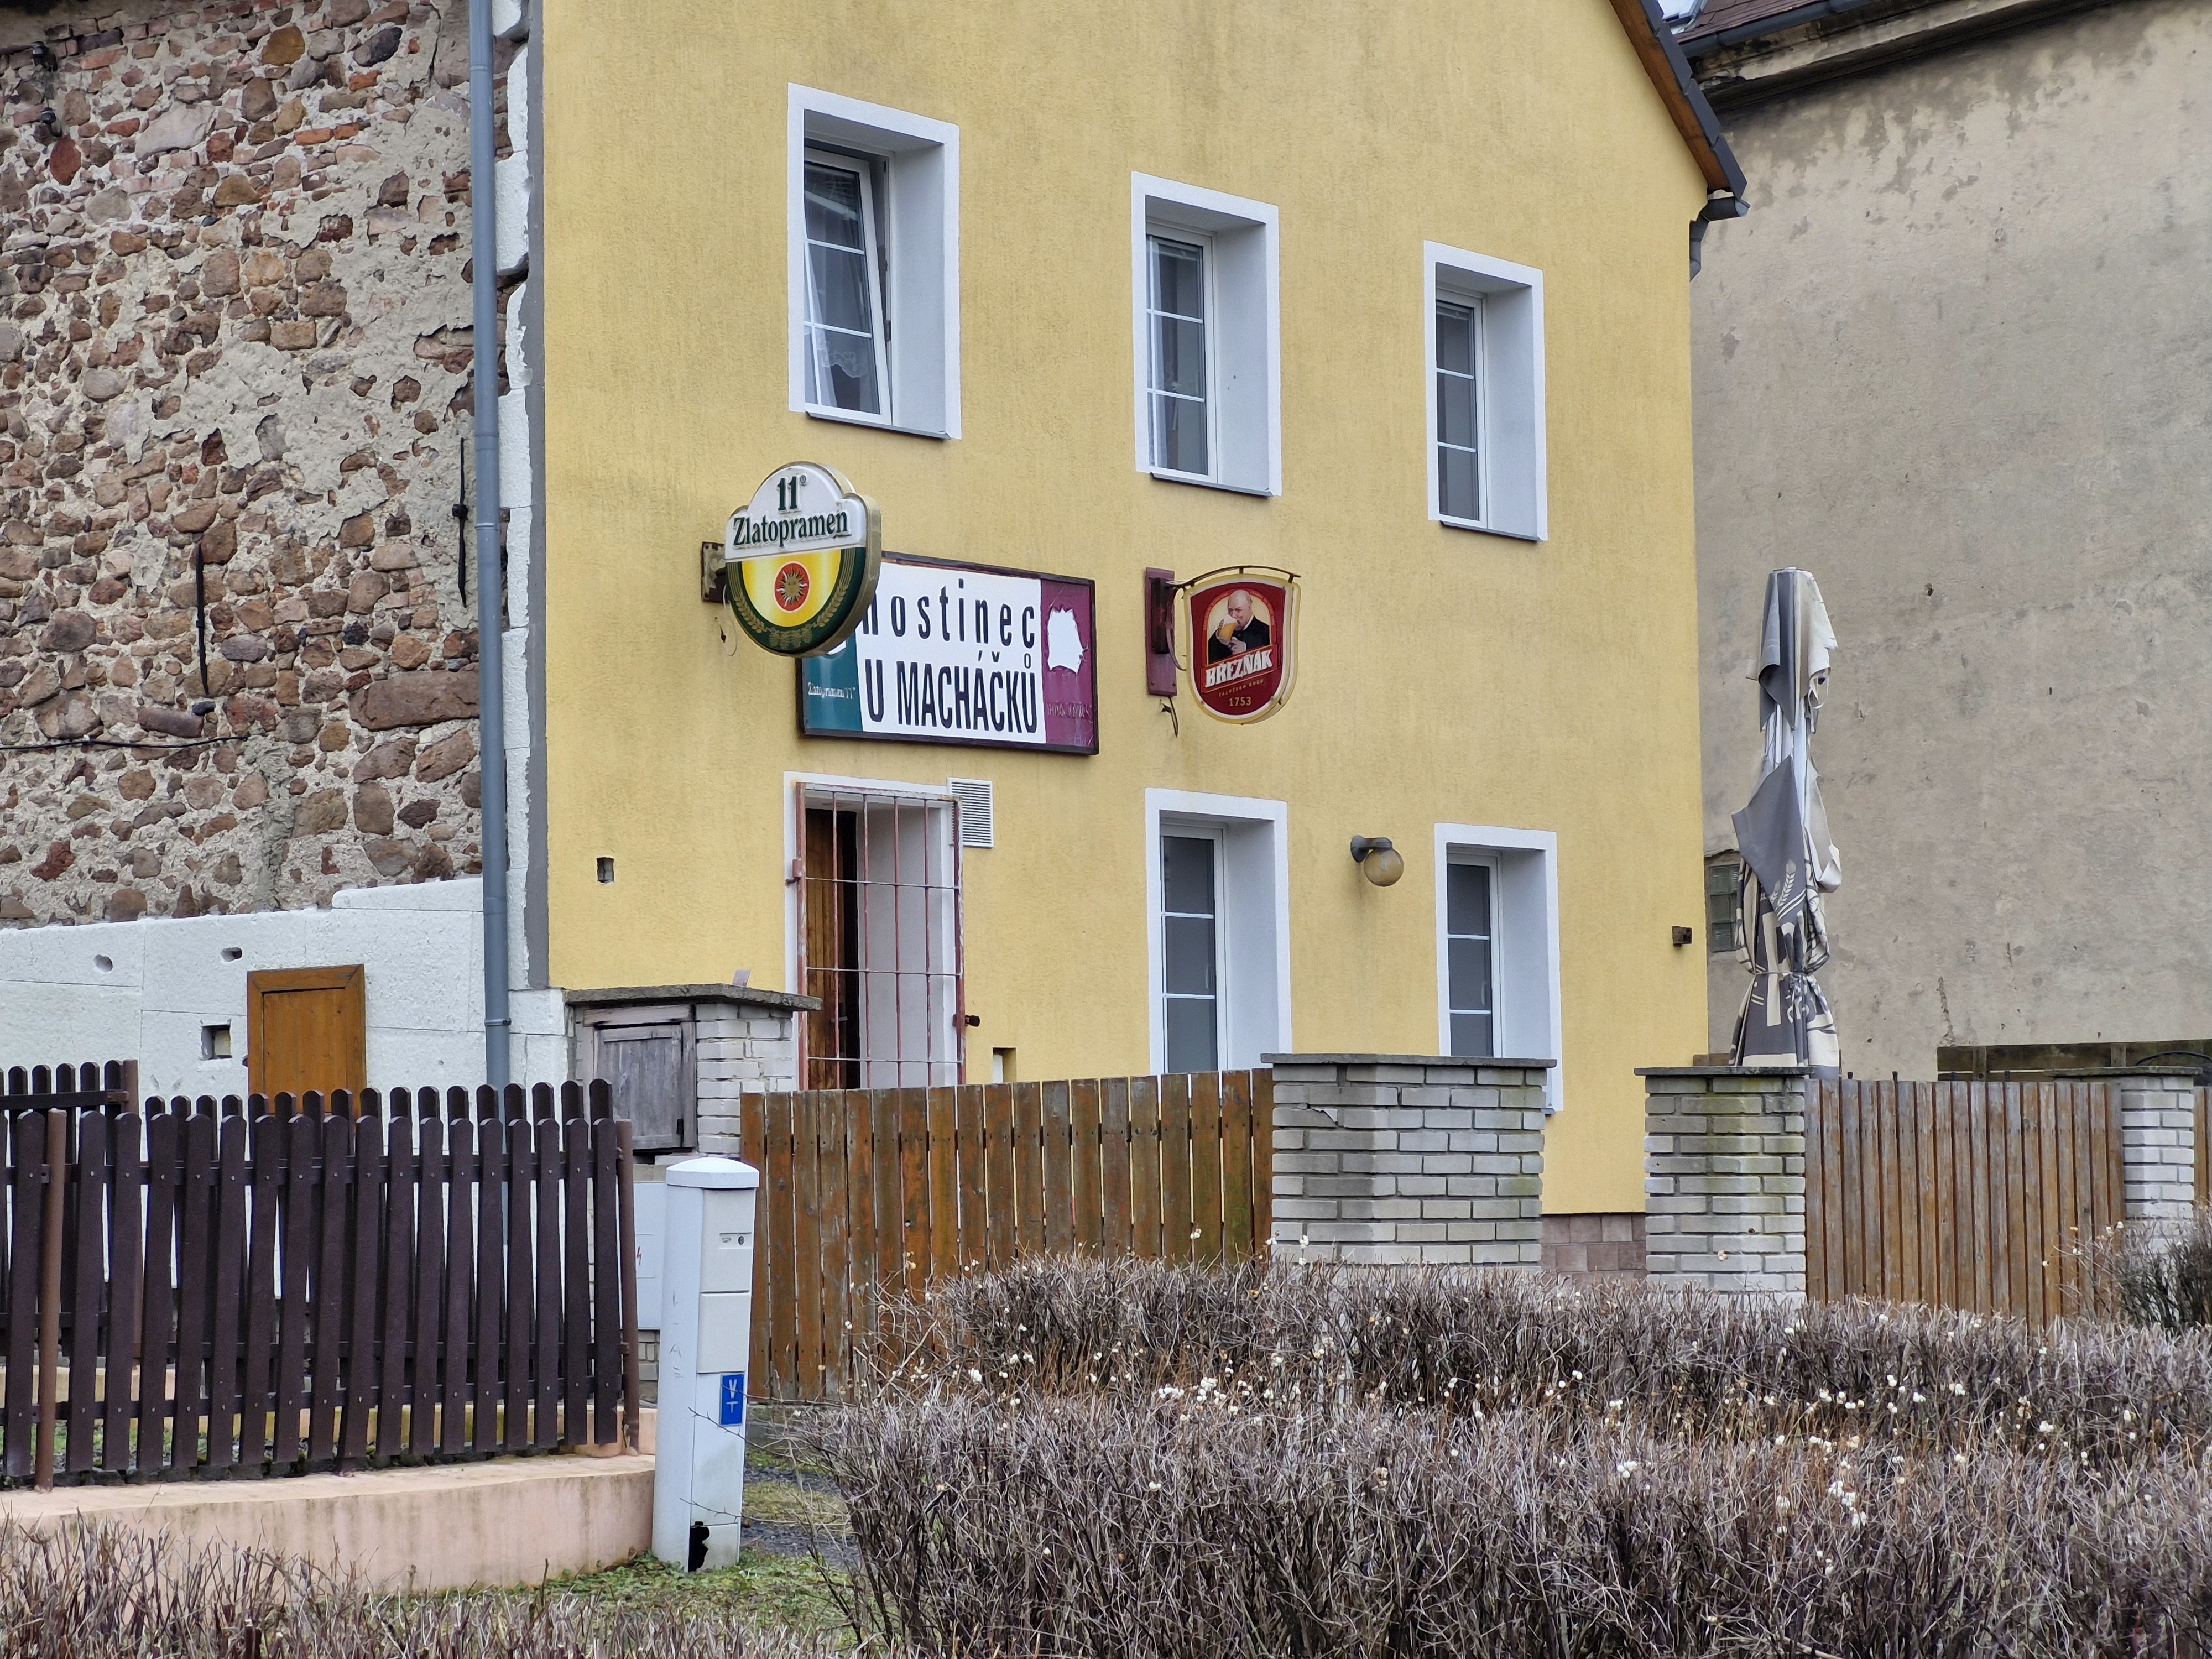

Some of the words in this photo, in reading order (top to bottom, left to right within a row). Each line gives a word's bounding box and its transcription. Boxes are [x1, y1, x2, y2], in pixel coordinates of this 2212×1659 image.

[733, 510, 848, 547] Zlatopramen
[865, 659, 884, 722] U
[896, 650, 1037, 734] MACHÁČKŮ
[1228, 696, 1251, 707] 1753
